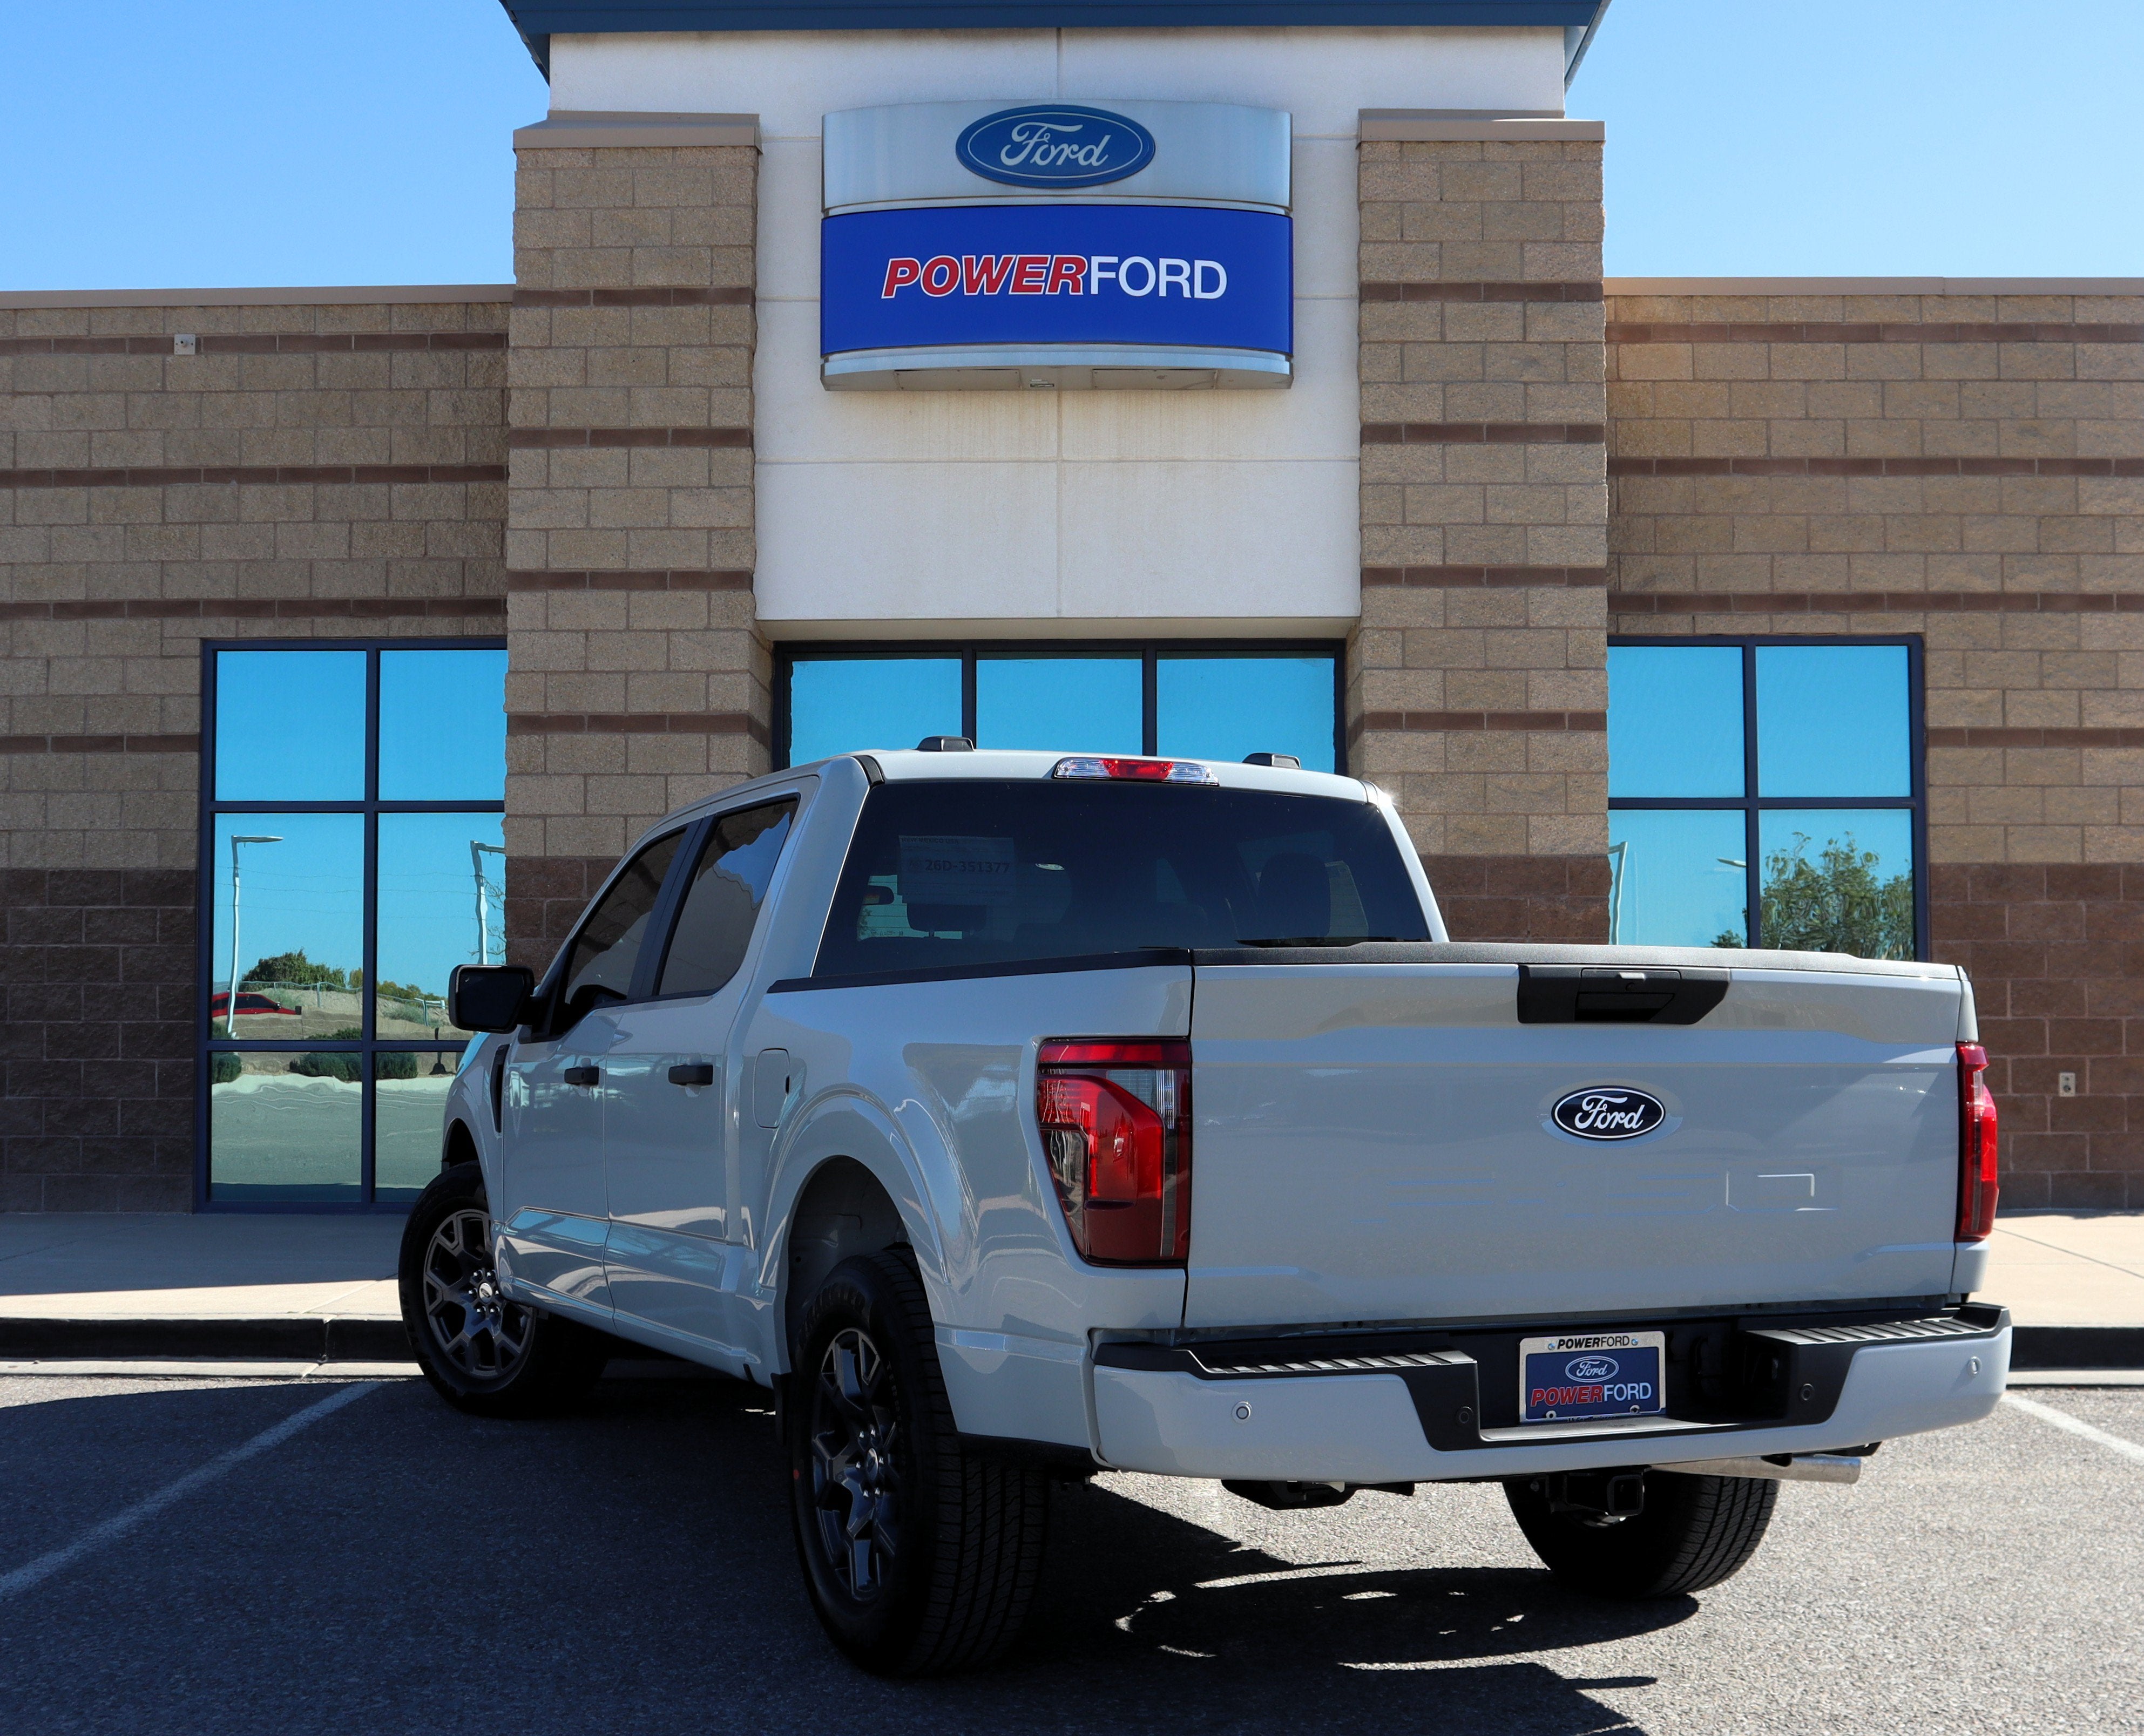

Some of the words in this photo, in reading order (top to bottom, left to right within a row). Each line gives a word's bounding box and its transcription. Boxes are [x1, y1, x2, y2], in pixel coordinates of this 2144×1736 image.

[1000, 121, 1111, 167] Ford
[881, 254, 1228, 300] POWERFORD
[925, 859, 1010, 873] 26D-351377
[1574, 1095, 1645, 1129] Ford
[1557, 1335, 1629, 1349] POWERFORD
[1576, 1361, 1607, 1376] Ford
[1531, 1382, 1652, 1407] POWERFORD
